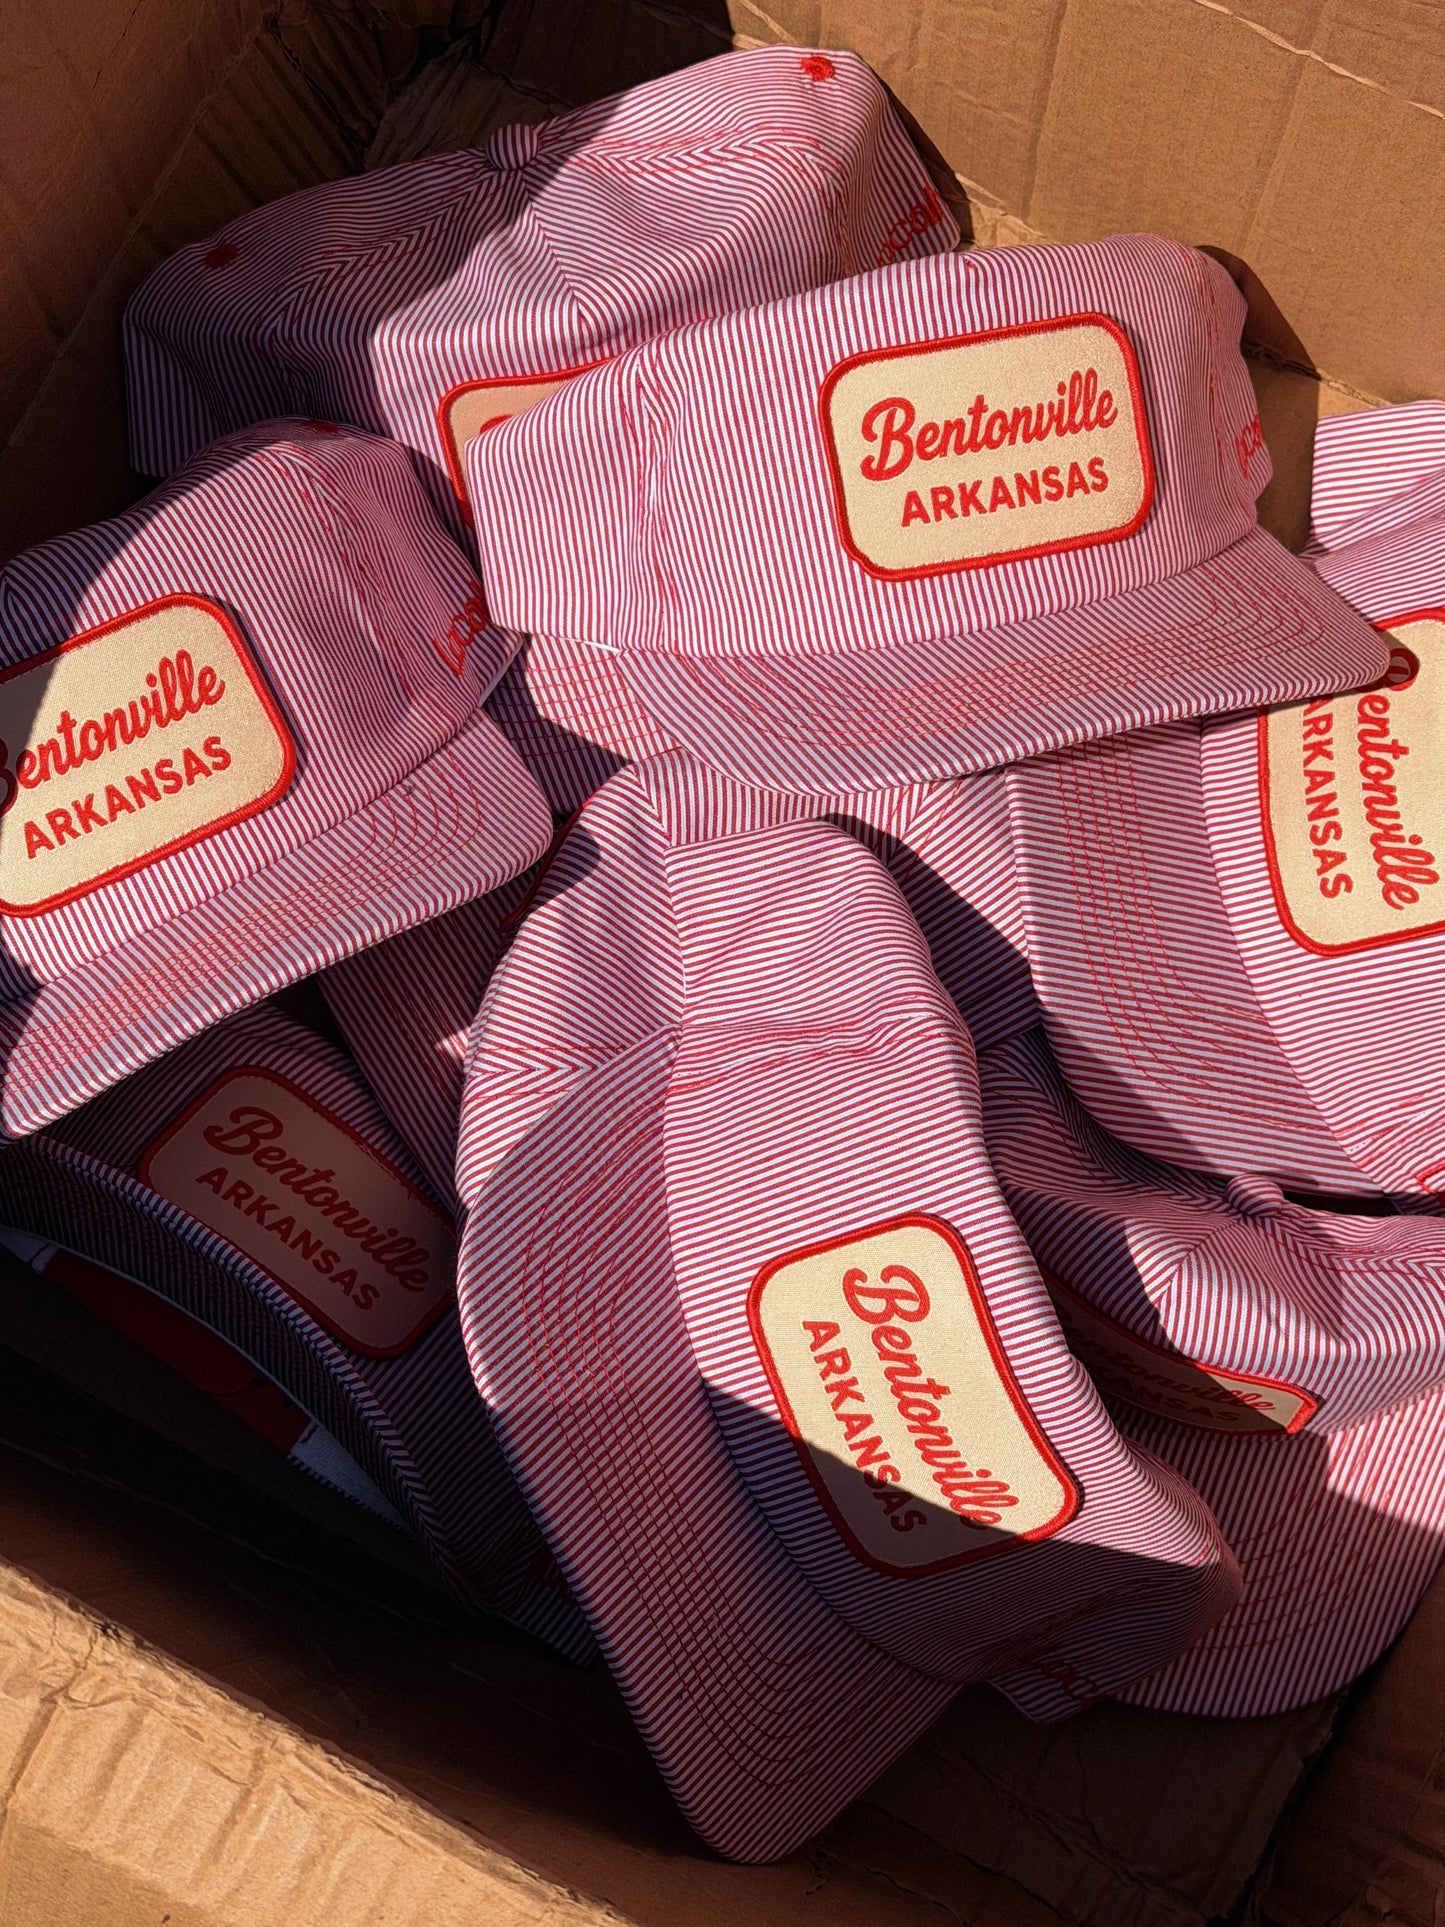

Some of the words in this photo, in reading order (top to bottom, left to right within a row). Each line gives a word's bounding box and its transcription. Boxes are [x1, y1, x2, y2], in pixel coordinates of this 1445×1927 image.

[860, 368, 1118, 481] Bentonville
[901, 457, 1109, 527] ARKANSAS
[0, 648, 225, 817] entonville
[23, 736, 231, 859] ARKANSAS
[1302, 694, 1354, 900] ARKANSAS
[194, 1167, 381, 1311] ARKANSAS
[203, 1106, 431, 1293] Bentonville
[802, 1320, 927, 1533] ARKANSAS
[842, 1264, 1020, 1531] Bentonville
[1057, 1302, 1277, 1412] entonville
